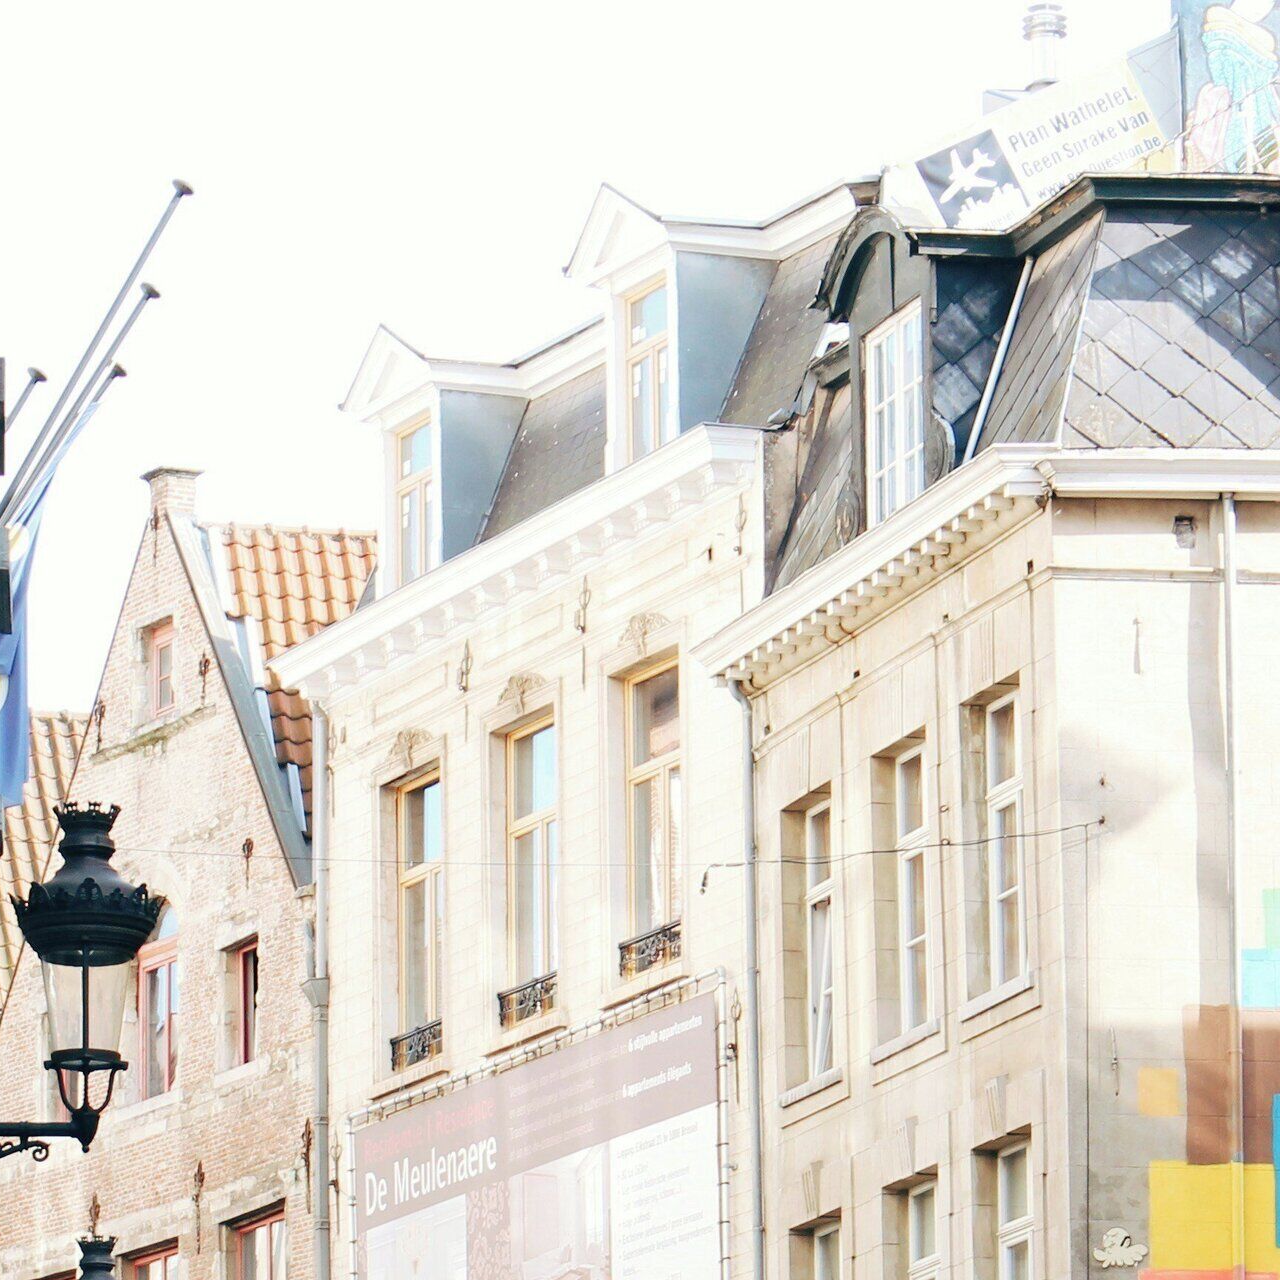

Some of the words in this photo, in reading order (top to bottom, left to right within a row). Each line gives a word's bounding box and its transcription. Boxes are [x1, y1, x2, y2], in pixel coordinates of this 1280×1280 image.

[1008, 124, 1050, 152] Plan
[1049, 86, 1138, 133] Wathelet,
[1021, 150, 1062, 177] Geen
[1062, 126, 1118, 159] Sprake
[1117, 111, 1150, 133] Van
[365, 1172, 387, 1217] De
[393, 1136, 498, 1205] Meulenaere
